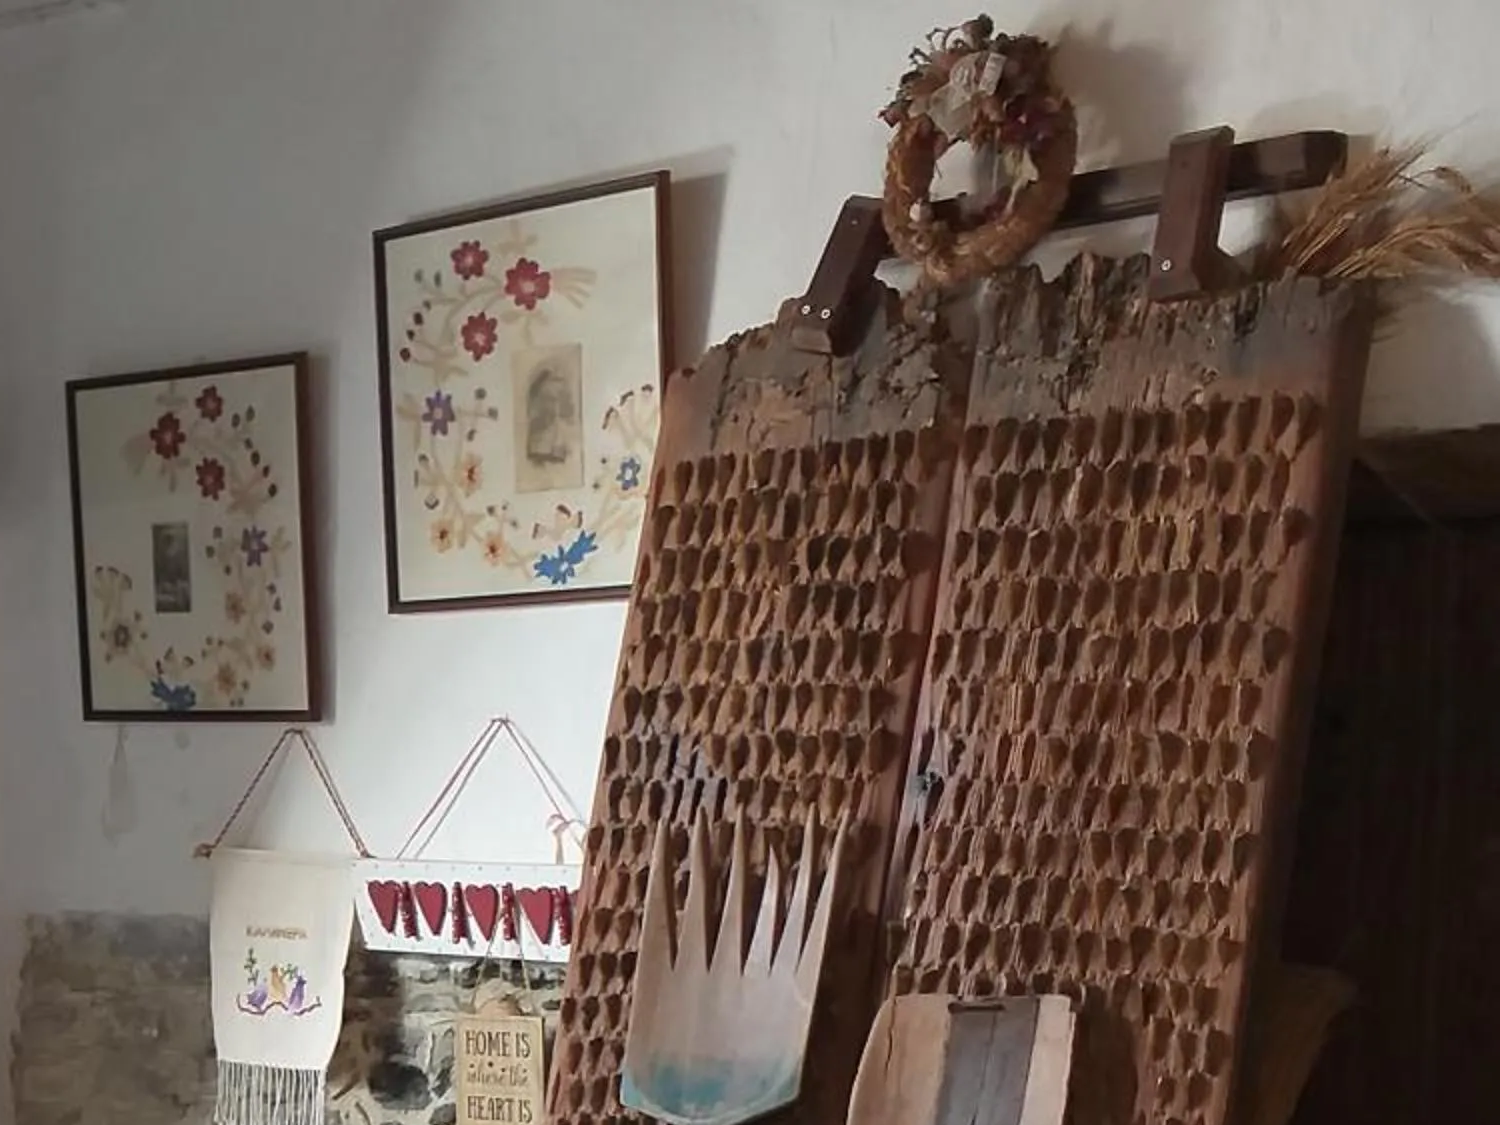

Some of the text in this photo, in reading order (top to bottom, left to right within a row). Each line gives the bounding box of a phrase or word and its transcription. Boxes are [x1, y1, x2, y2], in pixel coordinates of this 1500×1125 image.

[465, 1030, 531, 1058] HOME IS
[467, 1095, 533, 1124] HEART IS
